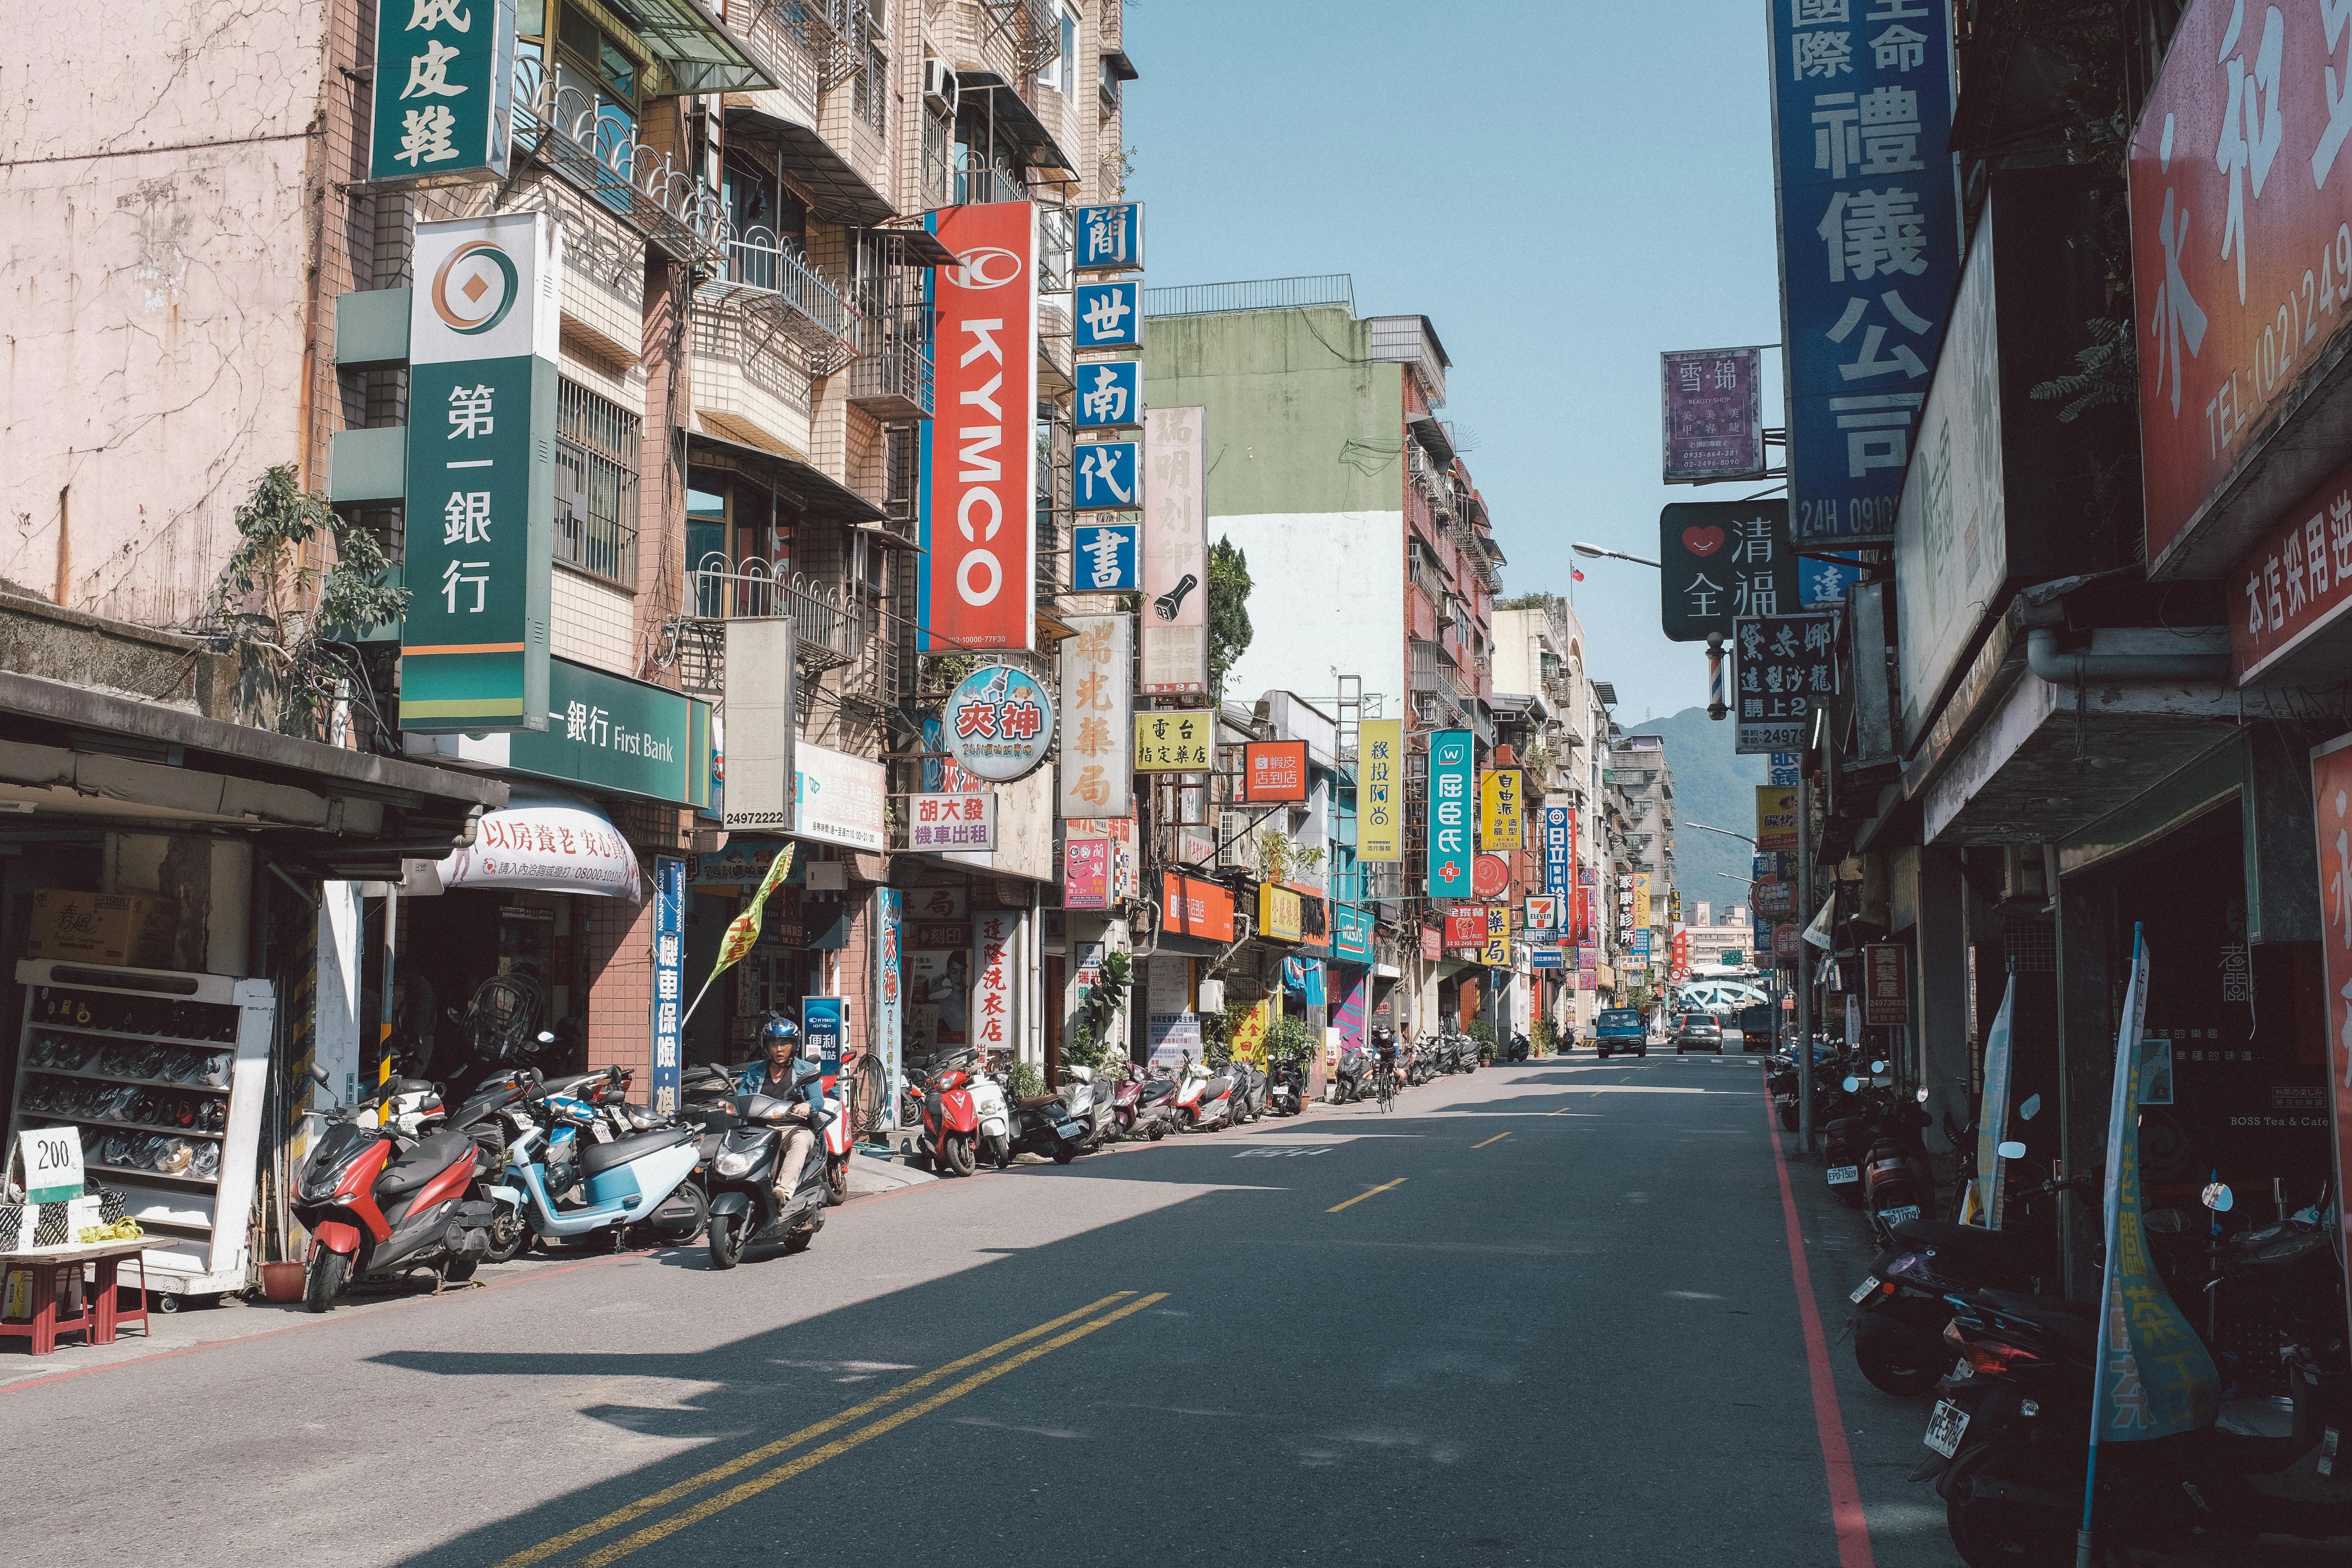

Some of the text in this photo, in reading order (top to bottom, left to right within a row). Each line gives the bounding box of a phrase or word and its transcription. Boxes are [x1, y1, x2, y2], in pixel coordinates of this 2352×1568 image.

[1811, 85, 1929, 477] 禮儀公司
[1080, 206, 1131, 588] 簡世南代書
[956, 318, 1003, 607] KYMCO
[1684, 458, 1740, 468] 02-2496-8090
[441, 383, 495, 614] 第一銀行
[1801, 499, 1837, 536] 24H
[1146, 683, 1199, 693] 請上2樓
[1741, 665, 1832, 693] 造型沙龍
[955, 700, 1042, 740] 夾神
[1070, 623, 1115, 806] 瑞光藥局
[1153, 719, 1194, 740] 電台
[614, 725, 674, 763] First Bank
[1255, 770, 1297, 785] 店到店
[1270, 756, 1297, 769] 蝦皮
[920, 798, 984, 822] 胡大發
[1496, 774, 1514, 815] 自由派
[726, 812, 784, 824] 24972222
[1438, 773, 1463, 853] 屈臣氏
[481, 820, 576, 854] 以房養老
[914, 825, 988, 846] 機車出租
[575, 868, 622, 883] 08000-10108
[1485, 910, 1505, 963] 藥局
[883, 924, 898, 1004] 夾神
[980, 917, 1007, 1042] 達隆洗衣店
[2230, 1116, 2329, 1126] BOSS Tea & Café
[38, 1140, 69, 1170] 200
